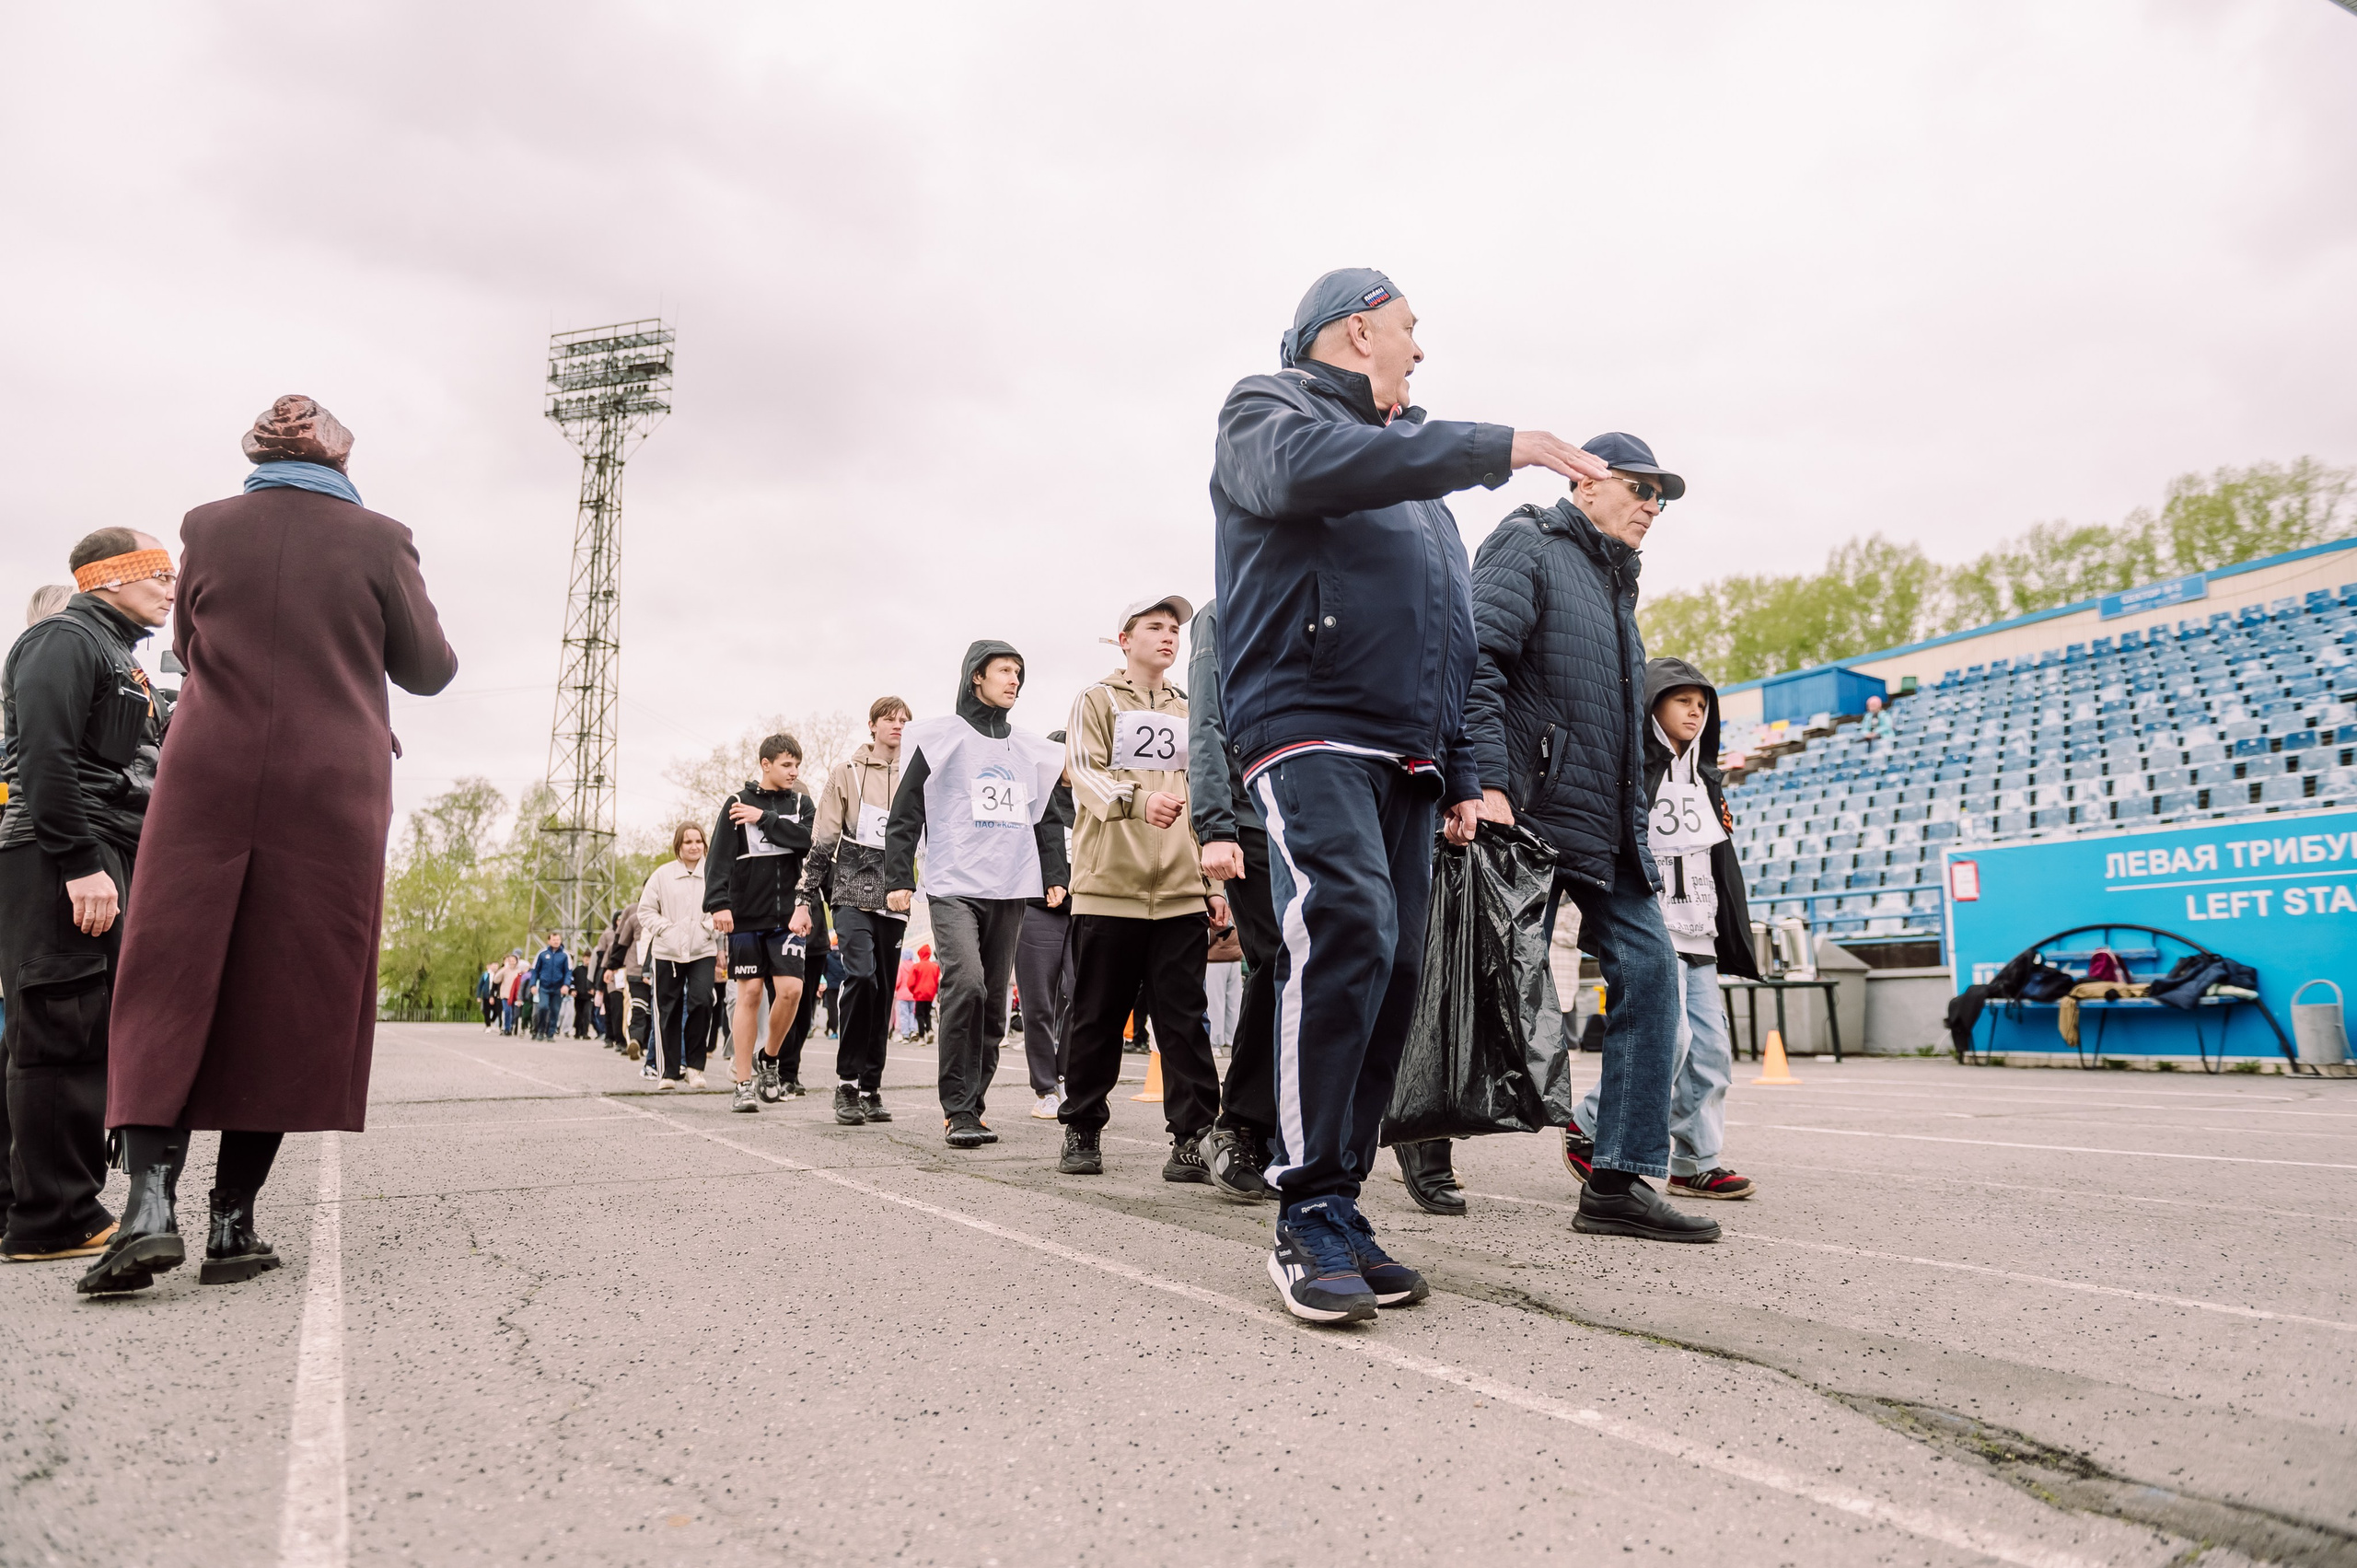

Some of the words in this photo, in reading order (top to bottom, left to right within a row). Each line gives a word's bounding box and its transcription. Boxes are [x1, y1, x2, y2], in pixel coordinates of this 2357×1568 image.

[1133, 726, 1176, 760] 23
[981, 785, 1014, 811] 34
[975, 820, 994, 829] ПАО
[1653, 797, 1701, 836] 35
[2105, 844, 2218, 879] ЛЕВАЯ
[2225, 832, 2357, 868] ТРИБУ
[2186, 889, 2273, 921] LEFT
[2283, 885, 2357, 916] STA
